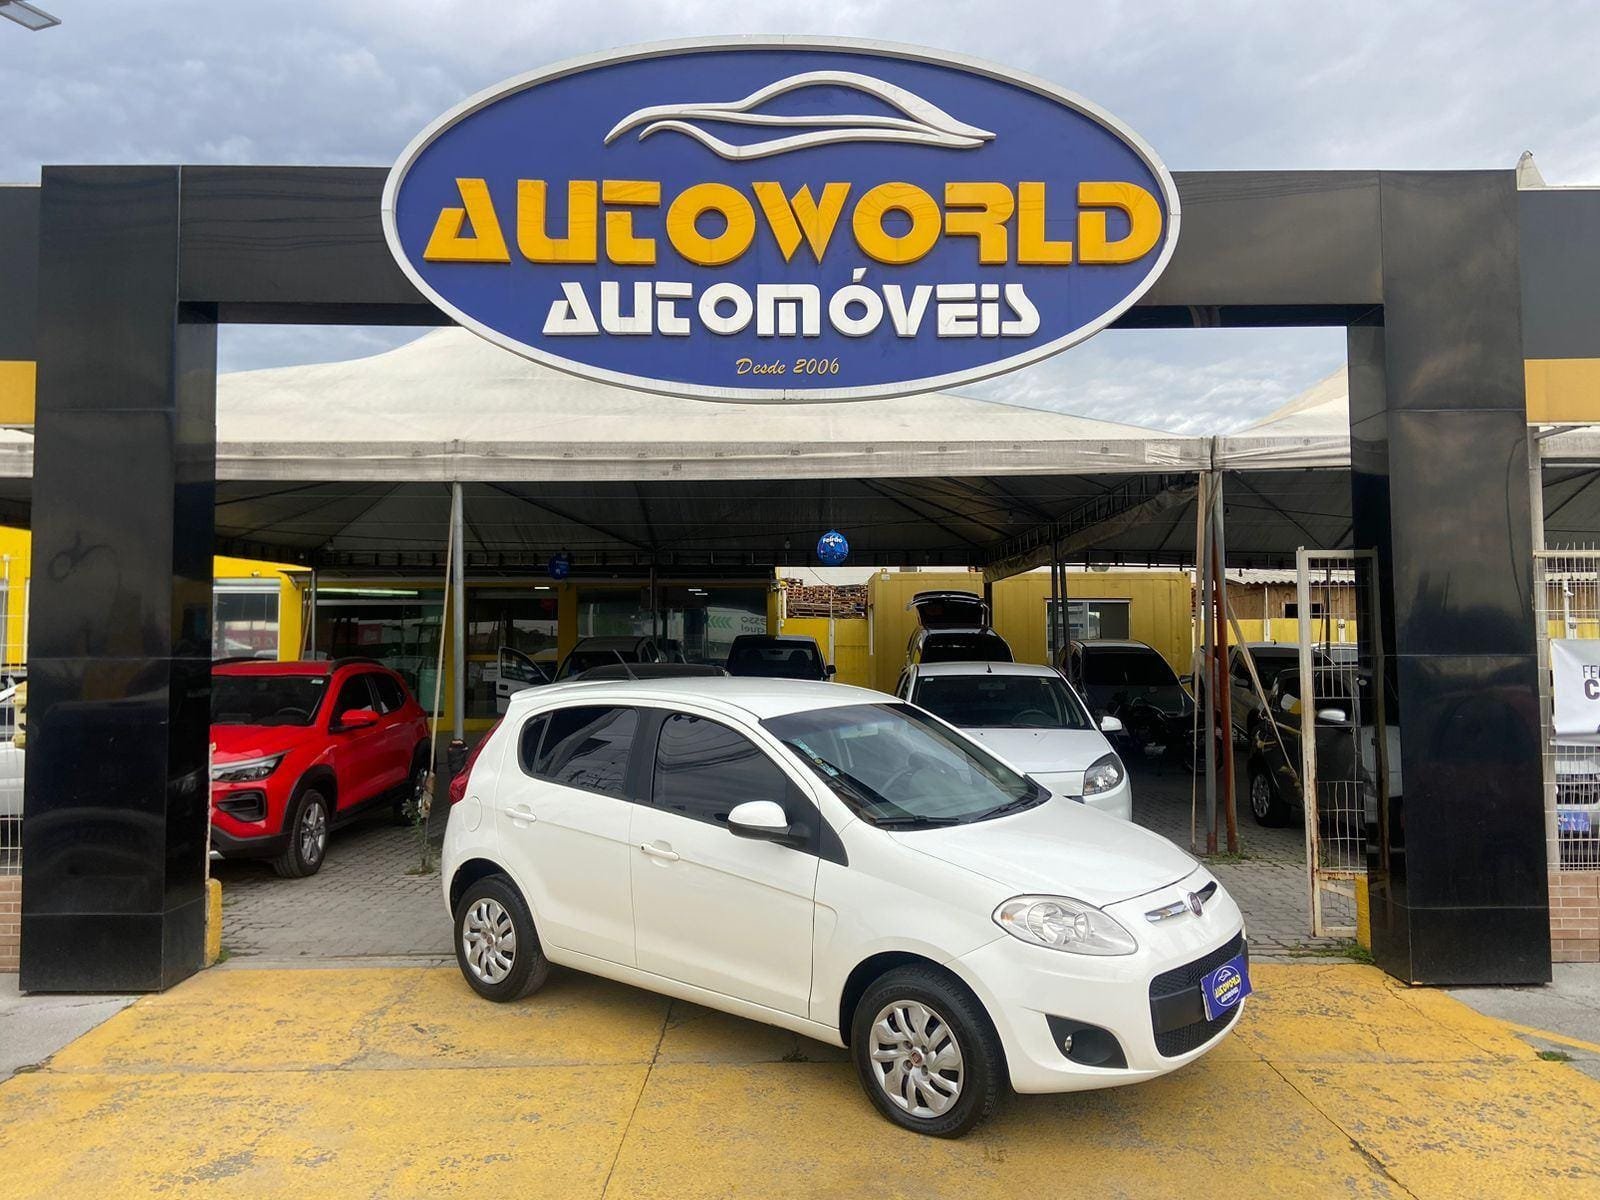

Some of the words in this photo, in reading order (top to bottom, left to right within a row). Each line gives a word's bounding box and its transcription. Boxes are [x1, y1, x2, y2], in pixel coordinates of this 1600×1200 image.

[424, 178, 1163, 265] AUTOWORLD
[542, 268, 1041, 337] AUTOMÓVEIS
[735, 357, 786, 375] Desde
[793, 357, 840, 375] 2006
